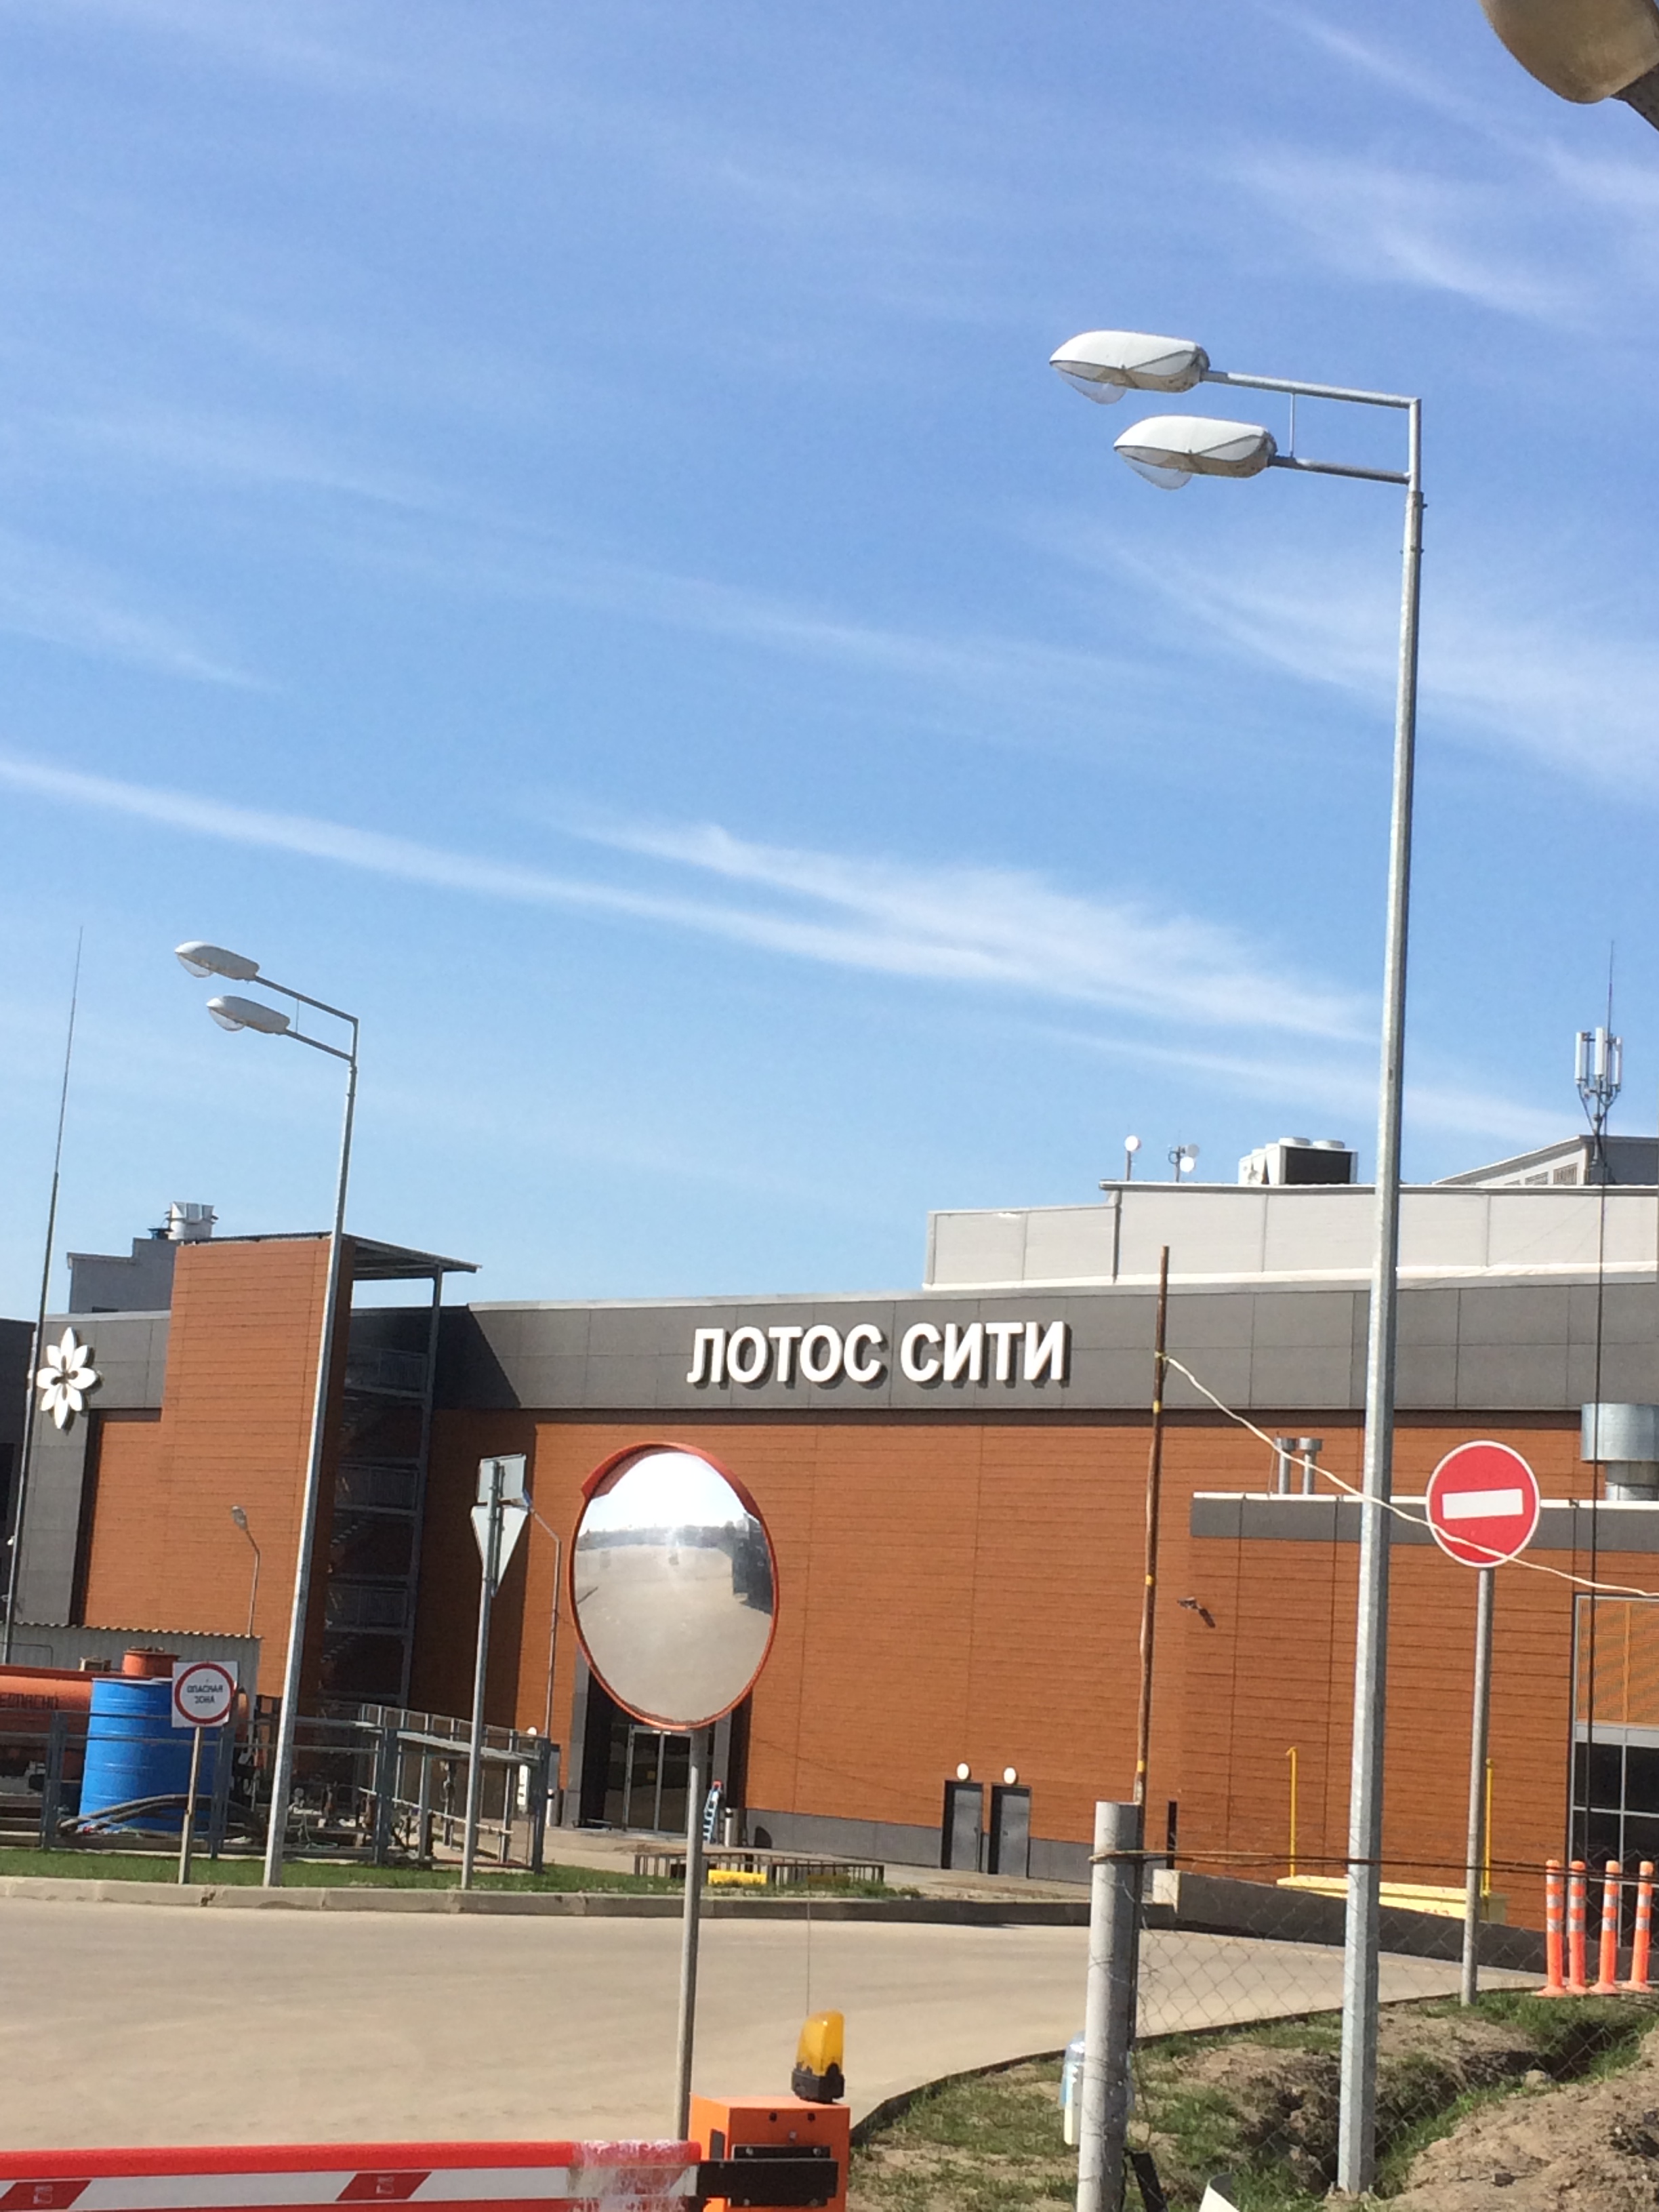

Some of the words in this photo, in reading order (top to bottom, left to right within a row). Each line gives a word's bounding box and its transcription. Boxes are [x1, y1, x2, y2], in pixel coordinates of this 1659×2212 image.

[686, 1324, 884, 1384] ЛОТОС
[900, 1320, 1067, 1382] СИТИ
[186, 1684, 224, 1694] ОПАСНАЯ
[194, 1695, 216, 1704] ЗОНА
